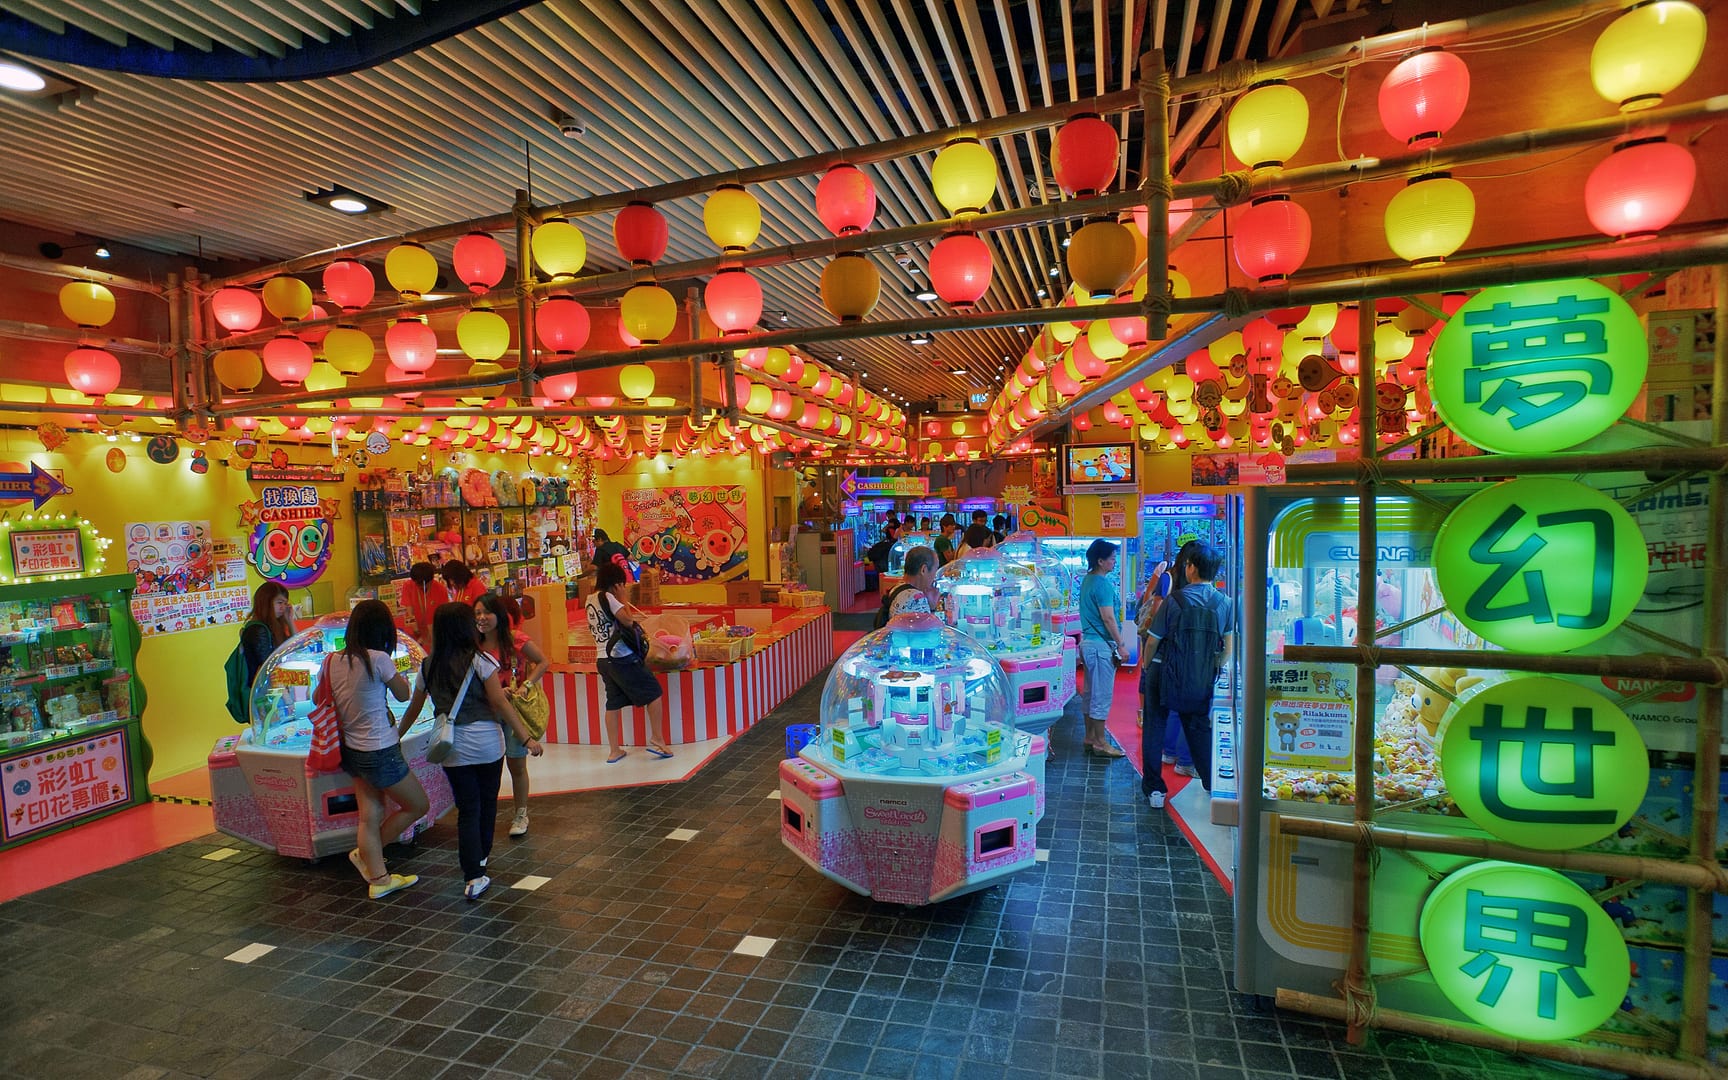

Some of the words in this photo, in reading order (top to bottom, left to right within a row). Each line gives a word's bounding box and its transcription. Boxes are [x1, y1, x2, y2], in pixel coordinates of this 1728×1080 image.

[264, 487, 317, 506] 找換處
[261, 507, 323, 521] CASHIER
[32, 543, 64, 556] 彩虹
[1632, 713, 1671, 722] NAMCO
[37, 758, 98, 796] 彩虹
[27, 780, 110, 825] 印花專櫃
